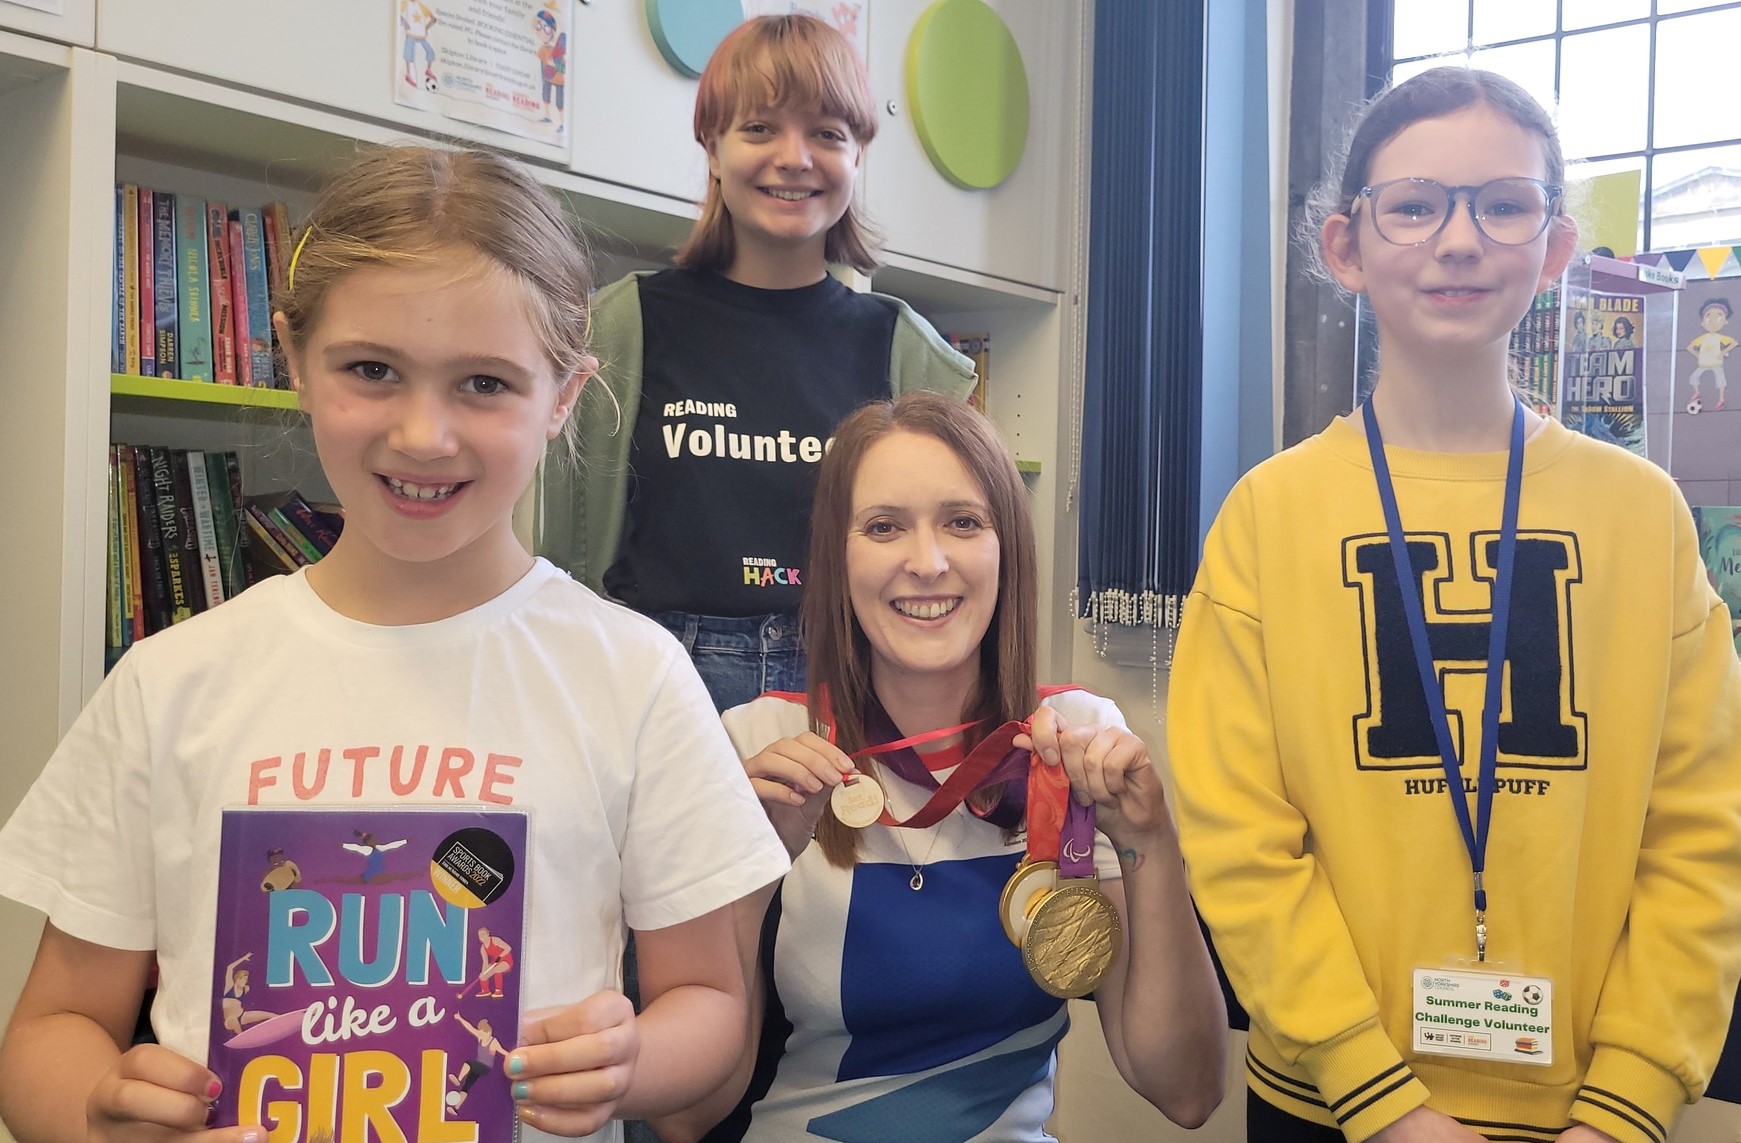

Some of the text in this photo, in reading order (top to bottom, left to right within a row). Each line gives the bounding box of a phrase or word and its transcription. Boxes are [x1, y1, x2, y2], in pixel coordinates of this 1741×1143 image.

[466, 54, 487, 65] Library
[156, 199, 173, 312] THE MEMORY THIEVES
[186, 247, 199, 283] NICOLA
[1656, 272, 1679, 284] Books
[217, 303, 229, 334] MISSION
[1600, 297, 1638, 312] BLADE
[158, 329, 166, 363] SIMPSON
[1568, 350, 1634, 376] TEAM
[1567, 376, 1636, 405] HERO
[663, 399, 737, 418] READING
[151, 456, 179, 540] NIGHT RAIDERS
[193, 465, 208, 502] WINTER
[199, 509, 216, 552] WARTIME
[209, 562, 218, 578] JAN
[742, 557, 777, 567] READING
[744, 567, 802, 587] HACK
[169, 556, 185, 607] SPARKES
[1341, 529, 1588, 770] H
[248, 744, 523, 805] FUTURE
[1405, 778, 1550, 795] HUFLPUFF
[447, 853, 486, 886] AWARDS 2022
[452, 846, 492, 881] SPORTS BOOK
[433, 868, 462, 894] WINNER
[266, 889, 469, 988] RUN
[300, 996, 446, 1045] like a
[1426, 996, 1538, 1017] Summer Reading
[1415, 1012, 1550, 1034] Challenge Volunteer
[238, 1050, 480, 1143] GIRL
